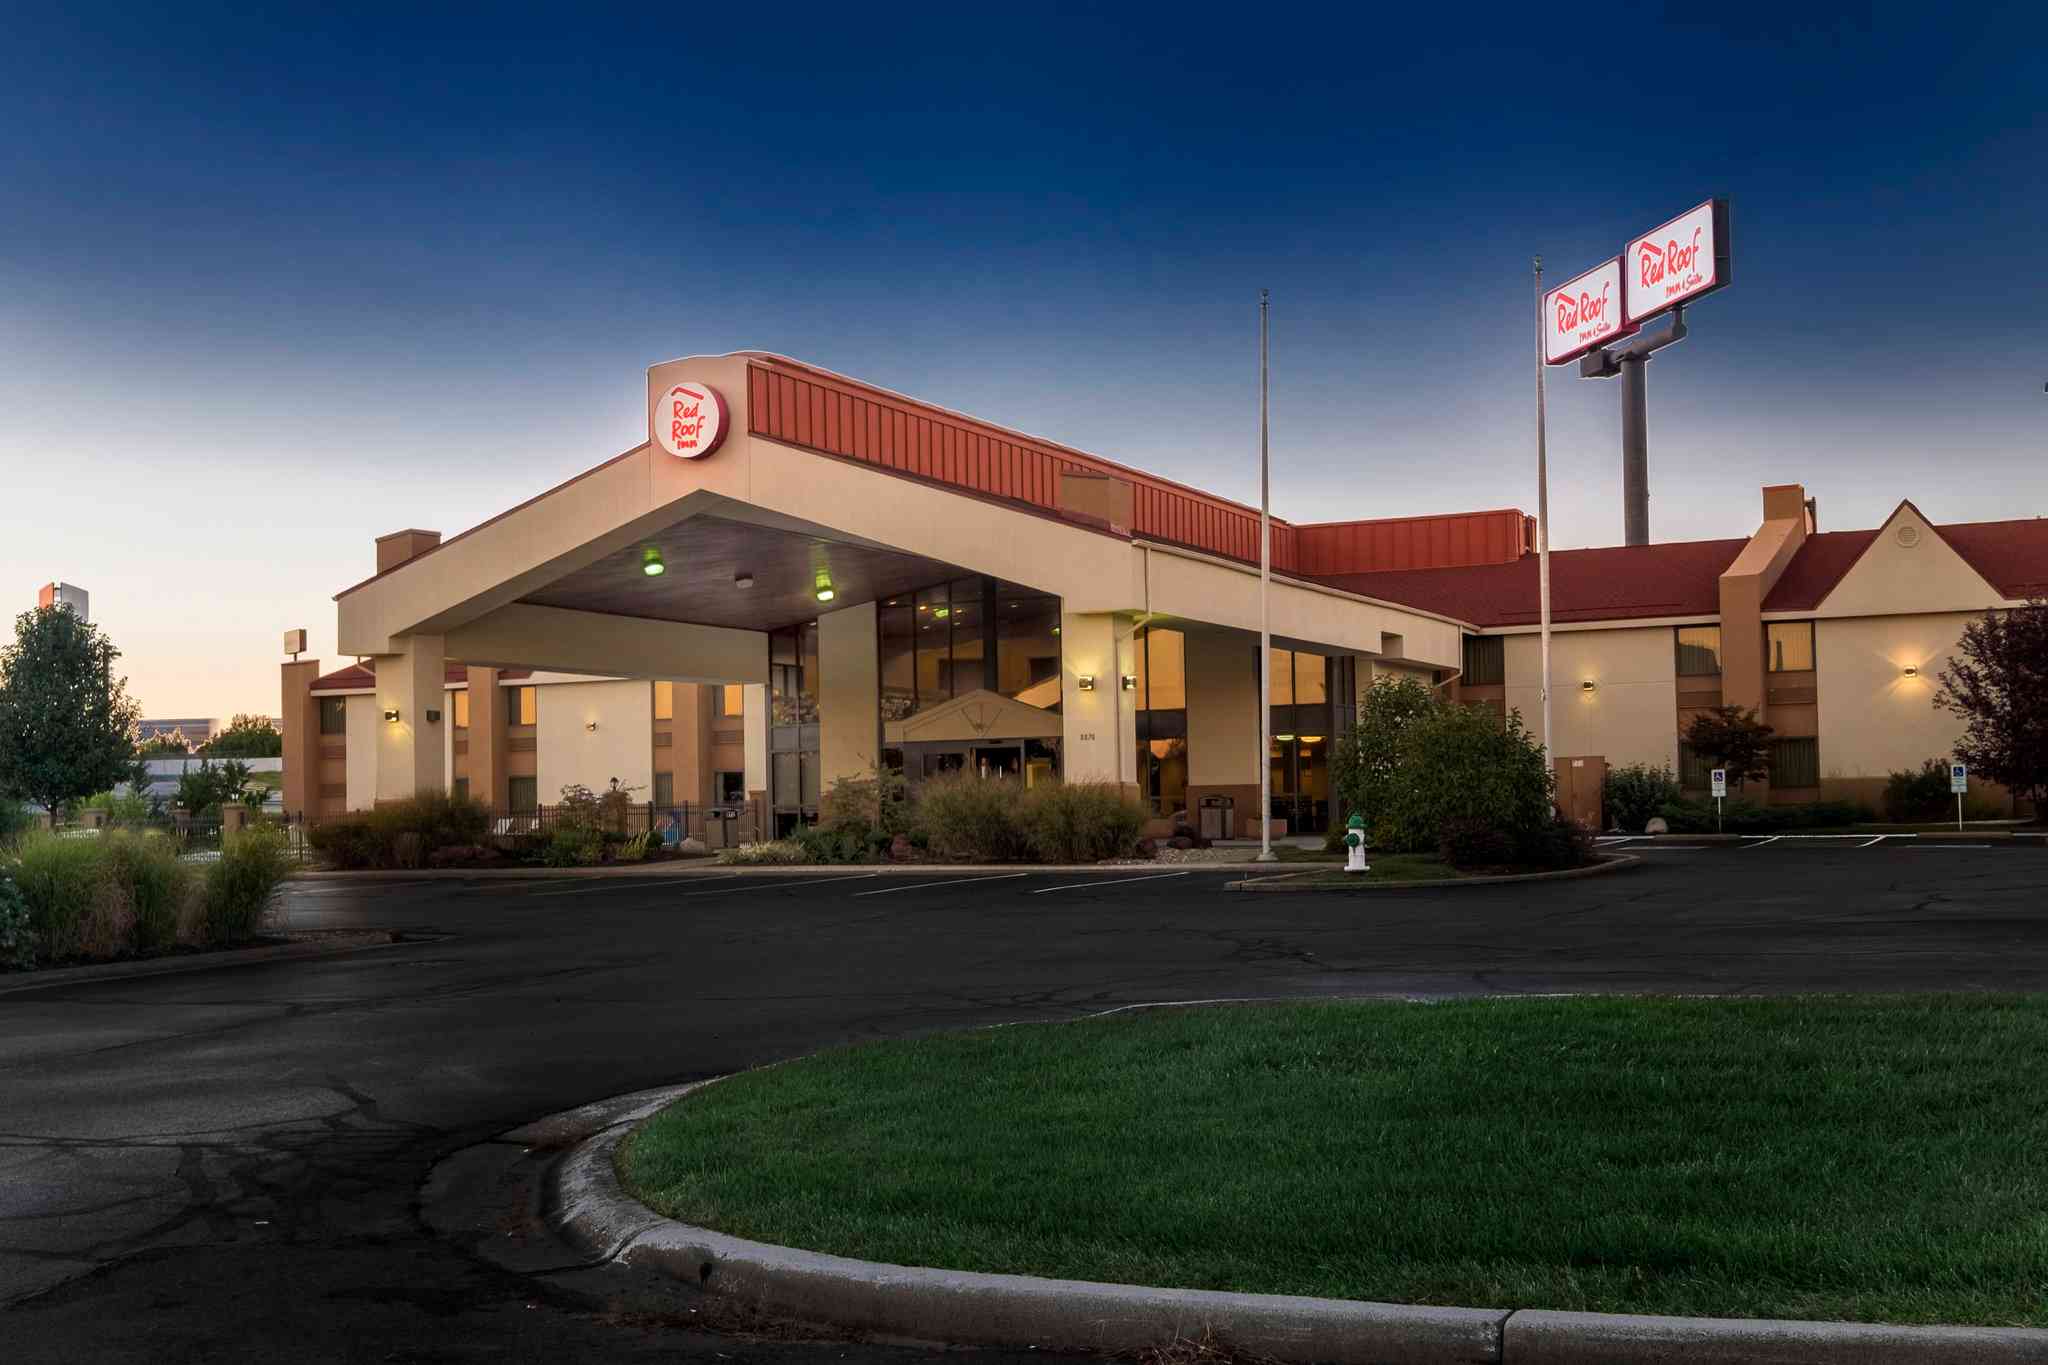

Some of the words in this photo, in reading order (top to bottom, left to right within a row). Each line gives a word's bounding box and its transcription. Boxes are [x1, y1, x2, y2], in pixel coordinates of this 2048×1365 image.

[1642, 252, 1665, 288] Red
[1668, 227, 1701, 274] Roof
[1558, 303, 1578, 334] Red
[1581, 281, 1609, 323] Roof
[672, 416, 705, 440] Roof
[673, 401, 699, 419] Red
